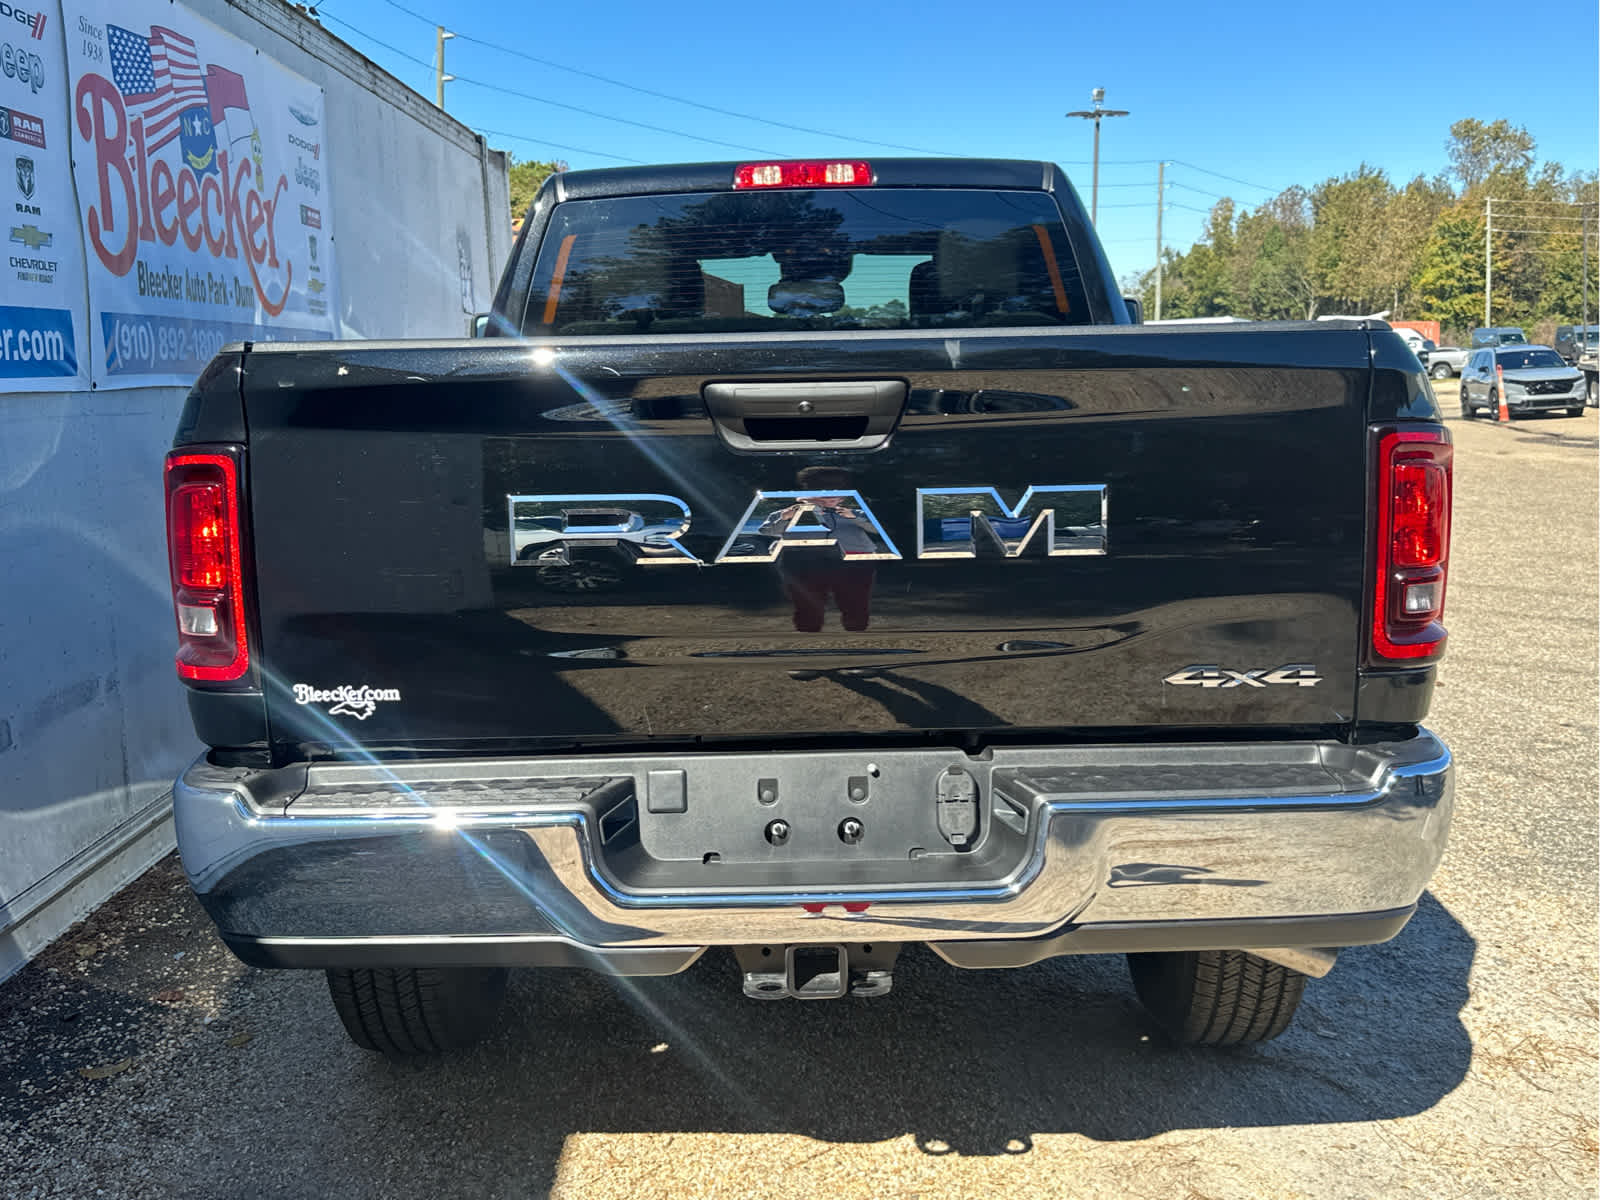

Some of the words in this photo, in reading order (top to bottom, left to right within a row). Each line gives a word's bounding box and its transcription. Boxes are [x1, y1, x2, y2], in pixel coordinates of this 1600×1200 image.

[79, 15, 103, 40] Since
[82, 40, 103, 63] 1938
[0, 42, 45, 94] eep
[13, 116, 42, 133] RAM
[15, 203, 41, 216] RAM
[10, 256, 58, 272] CHEVROLET
[137, 260, 183, 300] Bleecker
[185, 267, 206, 303] Auto
[208, 272, 229, 305] Park
[234, 276, 255, 307] Dunn
[115, 320, 154, 368] (910)
[507, 485, 1108, 566] RAM
